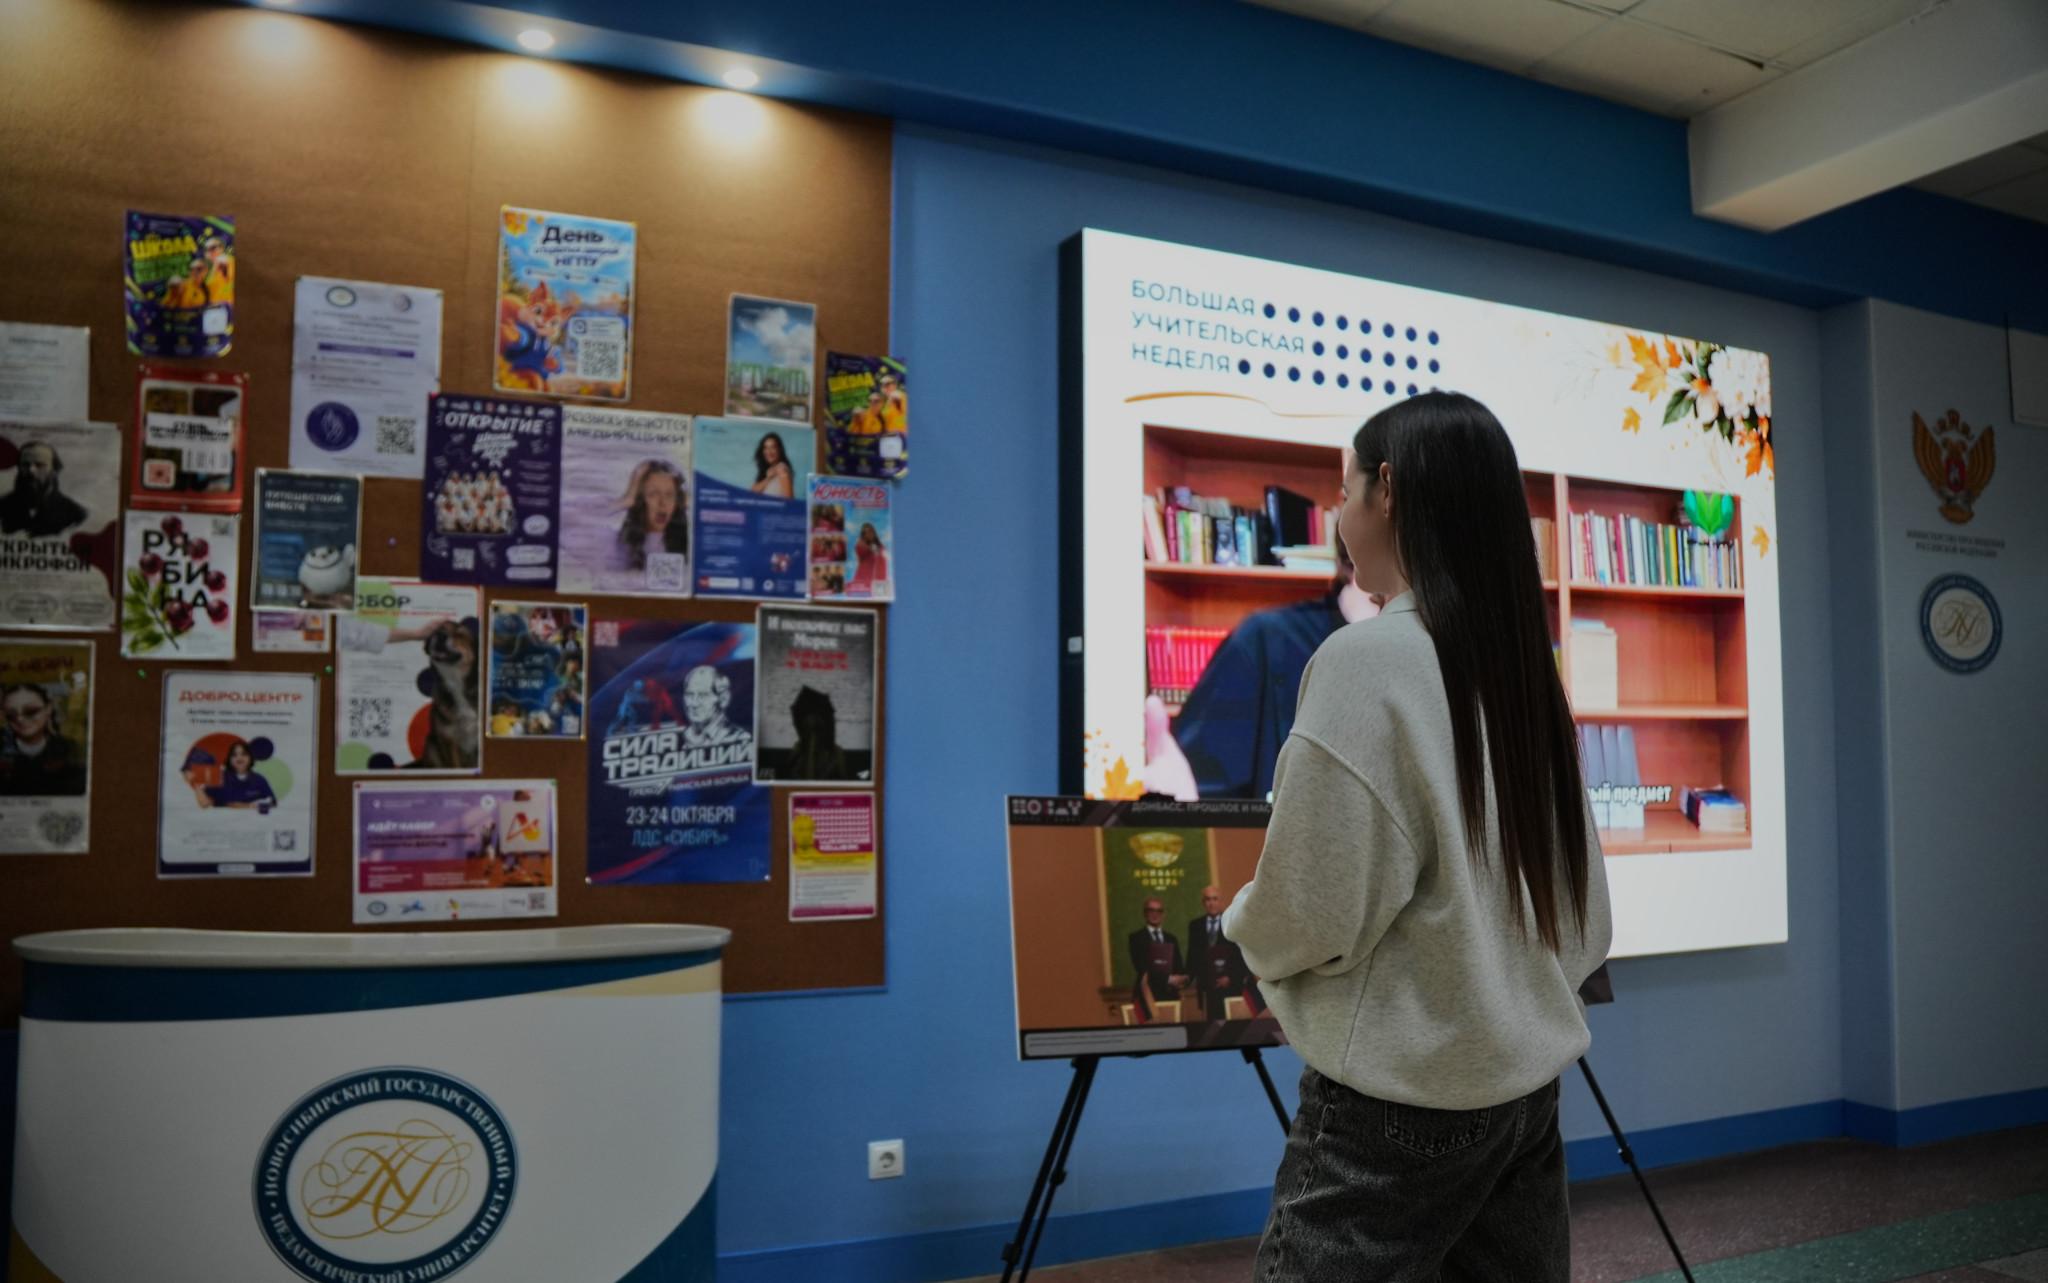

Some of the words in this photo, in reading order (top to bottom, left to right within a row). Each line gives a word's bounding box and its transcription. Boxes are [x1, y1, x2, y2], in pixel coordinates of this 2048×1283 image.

[542, 225, 604, 245] День
[1132, 279, 1255, 316] БОЛЬШАЯ
[1131, 311, 1304, 355] УЧИТЕЛЬСКАЯ
[1131, 343, 1230, 373] НЕДЕЛЯ
[444, 410, 545, 435] ОТКРЫТИЕ
[143, 529, 193, 557] РЯ
[161, 560, 210, 586] БИ
[179, 690, 303, 704] ДОБРО.ЦЕНТР
[603, 733, 679, 761] СИЛА
[603, 742, 754, 779] ТРАДИЦИЙ
[1587, 782, 1611, 802] ый
[1614, 786, 1672, 806] предмет
[626, 805, 669, 826] 23-24
[671, 804, 737, 825] ОКТЯБРЯ
[1186, 803, 1239, 814] ПРОШЛОЕ
[632, 829, 663, 848] ЛДС
[664, 829, 729, 846] «СИБИРЬ»
[264, 1076, 382, 1197] НОВОСИБИРСКИЙ
[385, 1078, 511, 1180] ГОСУДАРСТВЕННЫЙ
[409, 1192, 507, 1279] УНИВЕРСИТЕТ
